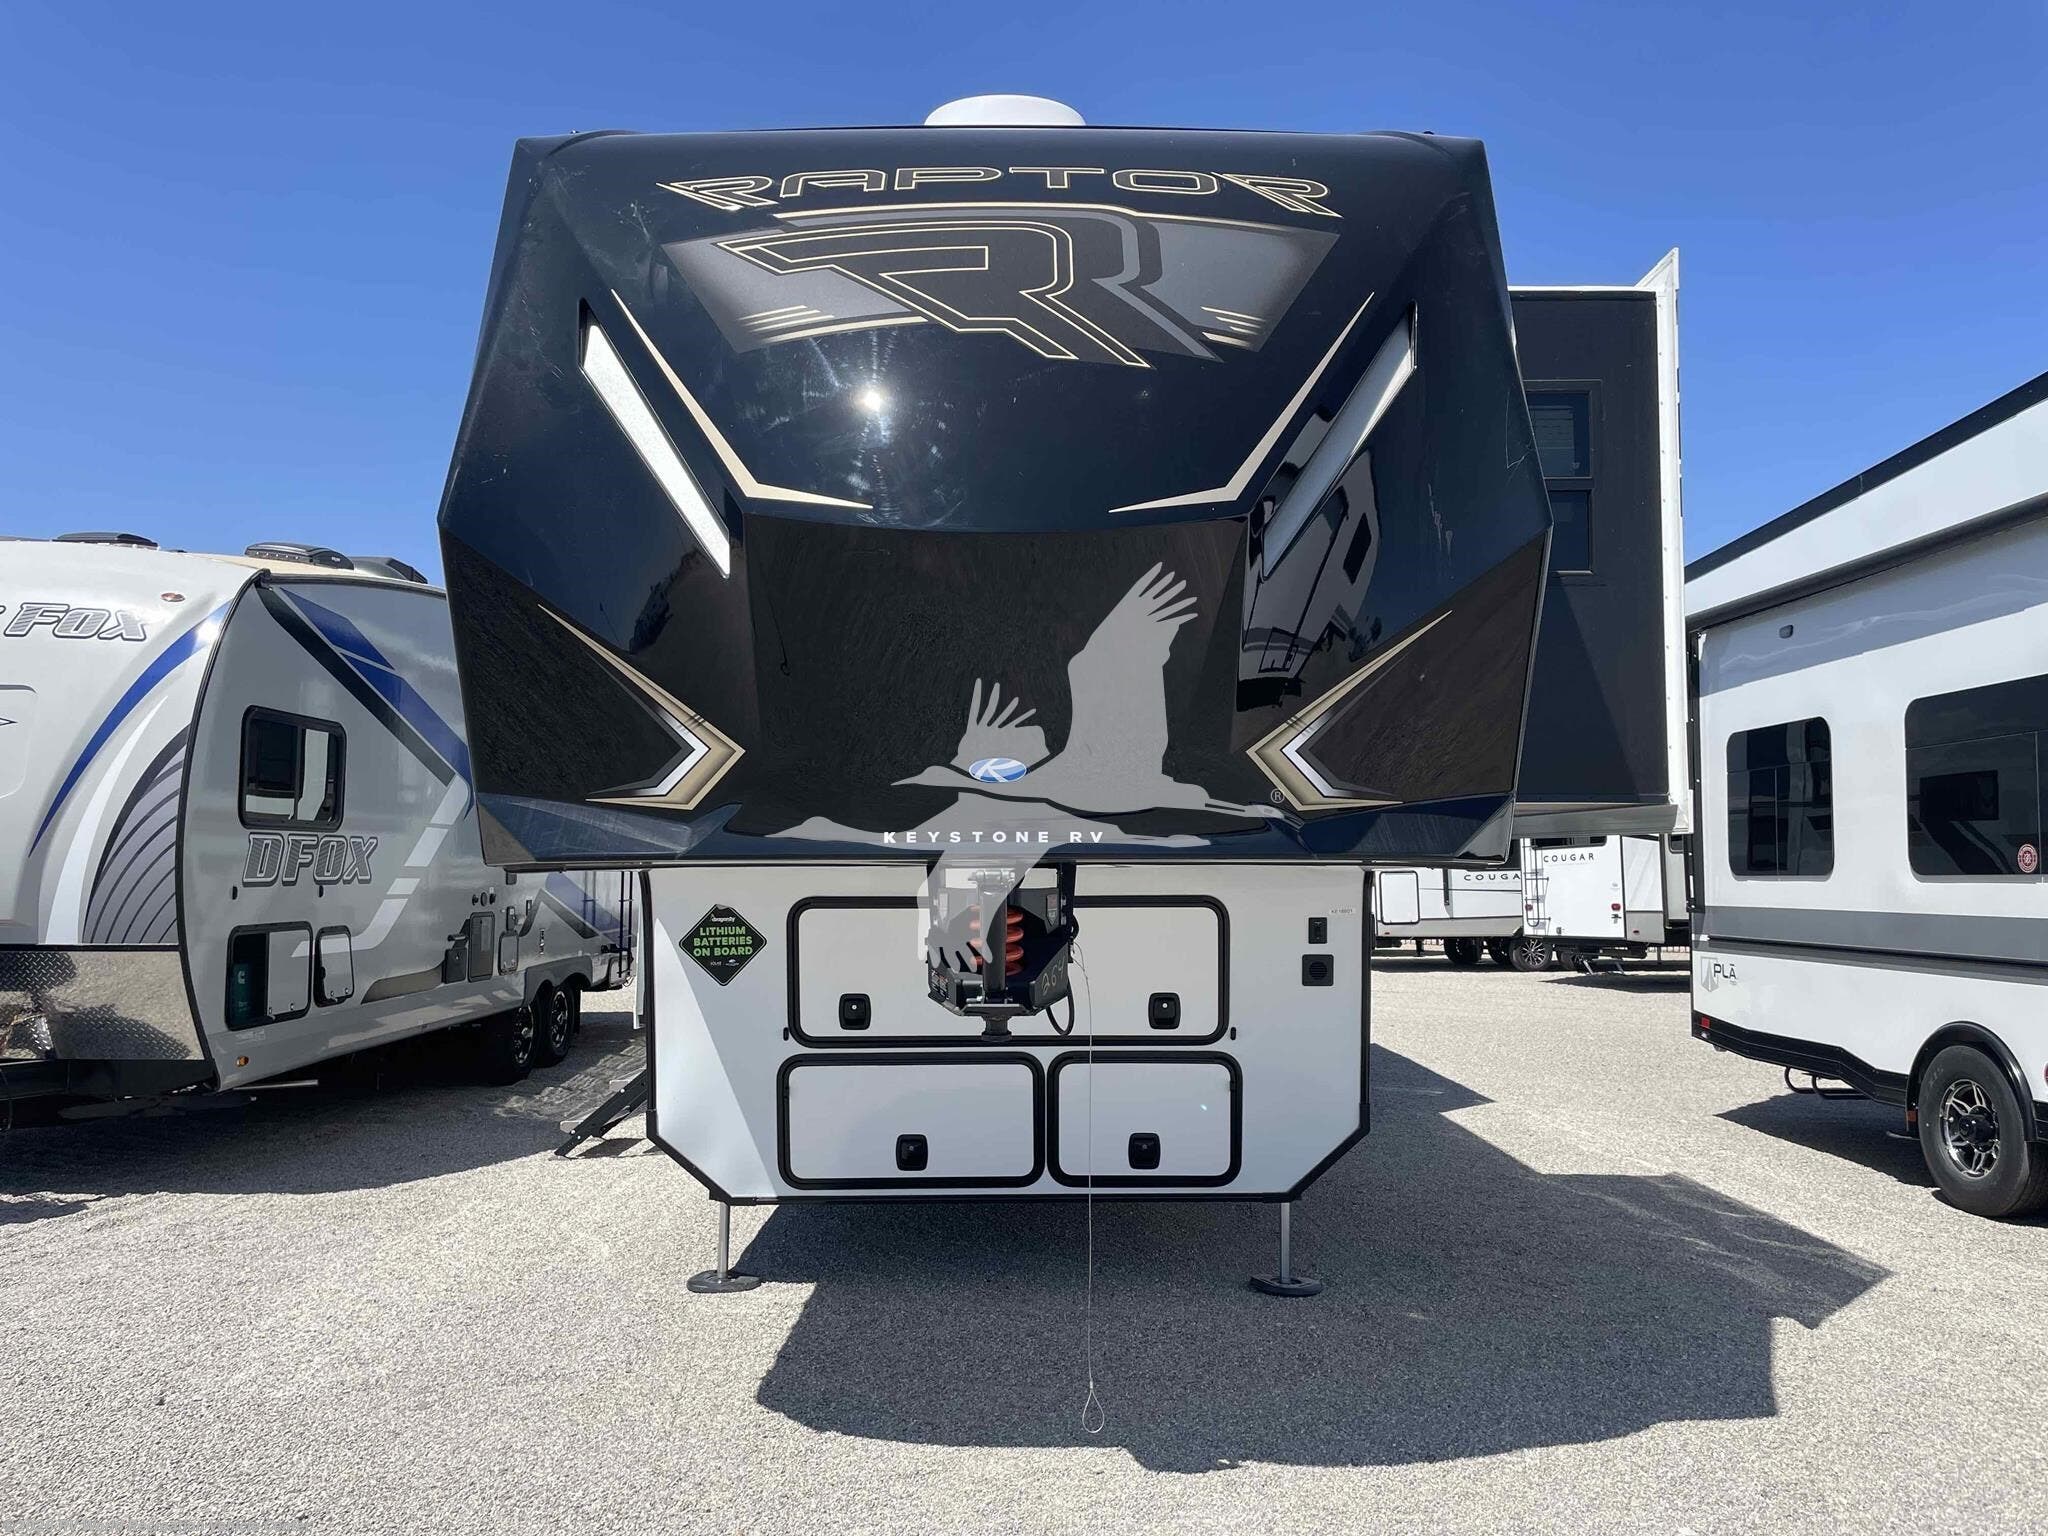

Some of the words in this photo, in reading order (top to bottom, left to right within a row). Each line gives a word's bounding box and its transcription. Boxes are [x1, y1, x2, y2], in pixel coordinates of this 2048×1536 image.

[656, 166, 1343, 218] RAPTOR
[883, 831, 1049, 844] KEYSTONE
[1069, 831, 1104, 844] RV
[242, 832, 378, 887] DFOX
[1543, 852, 1595, 863] COUGAR
[1463, 873, 1521, 882] COUGA
[699, 926, 746, 936] LITHIUM
[693, 936, 753, 947] BATTERIES
[692, 947, 711, 957] ON
[713, 946, 753, 956] BOARD
